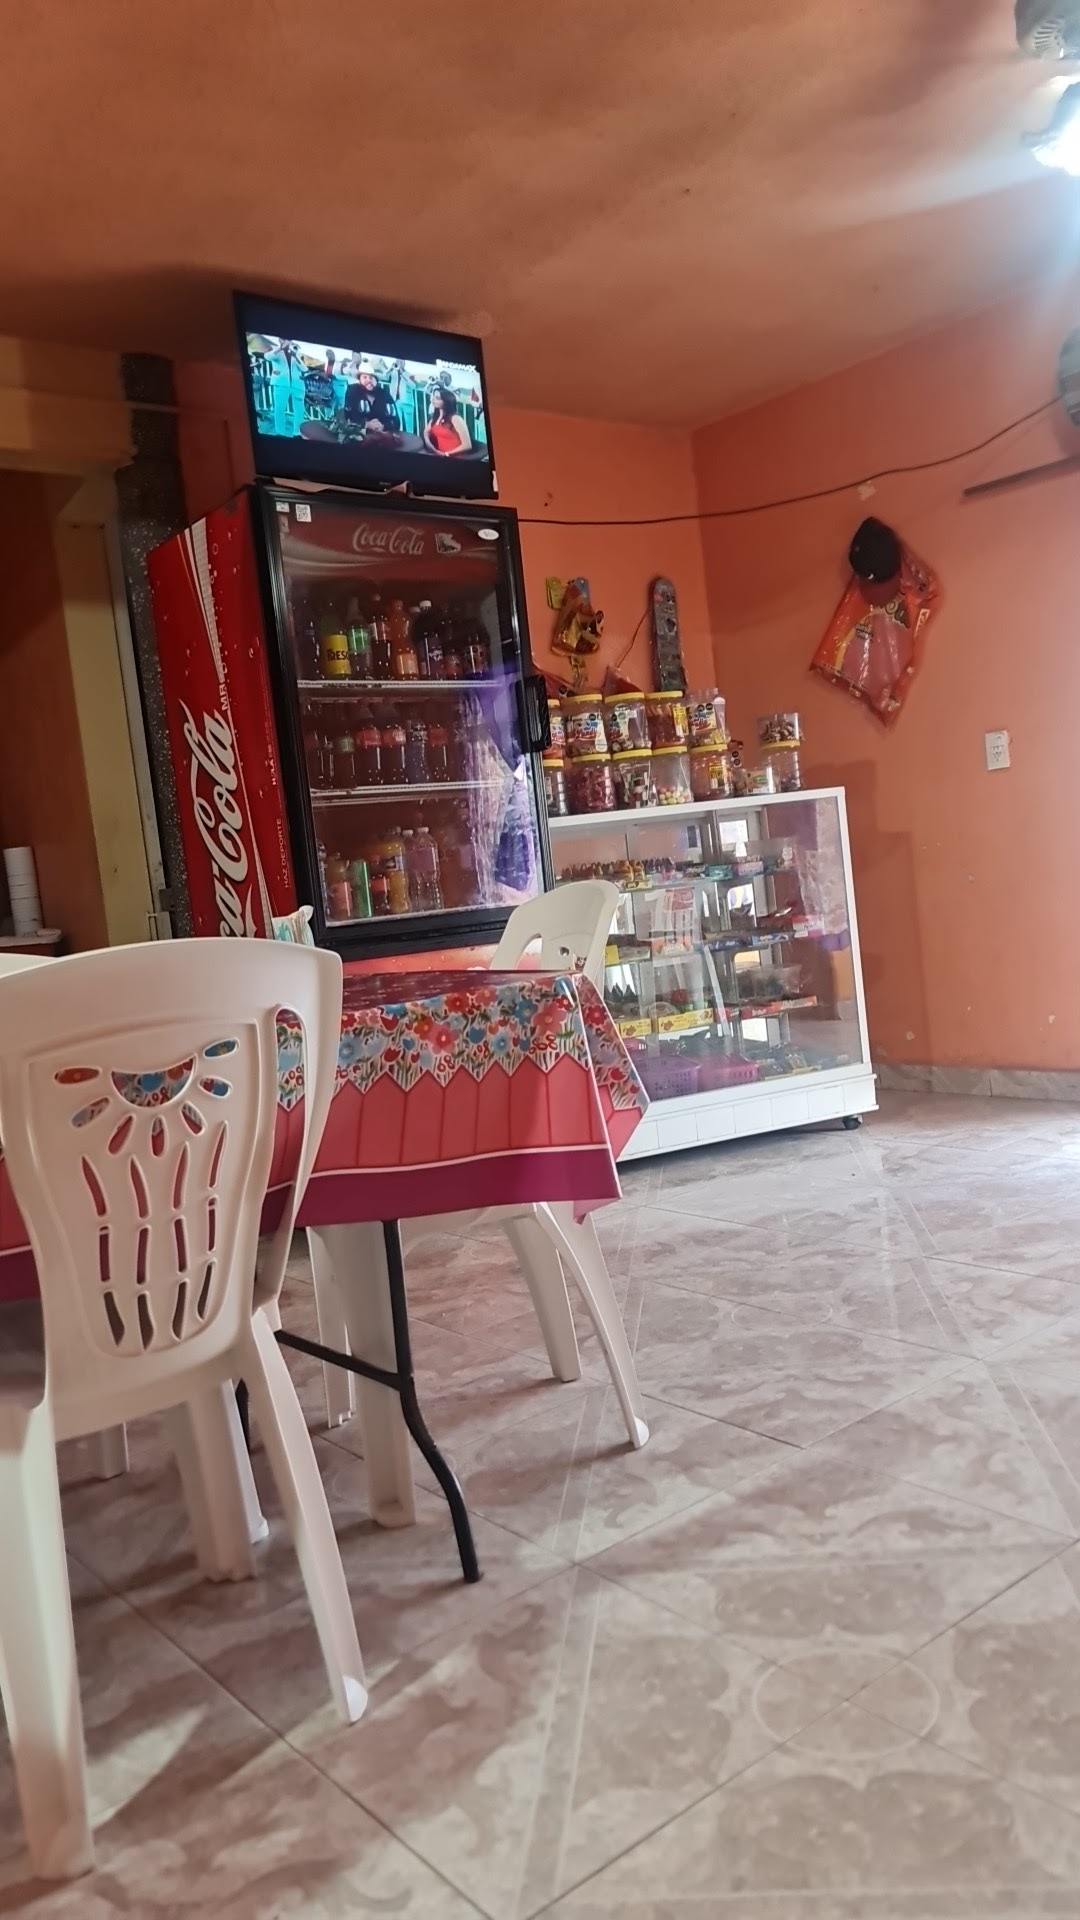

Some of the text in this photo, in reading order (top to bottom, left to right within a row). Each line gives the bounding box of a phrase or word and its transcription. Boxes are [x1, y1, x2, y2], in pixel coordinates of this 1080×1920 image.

[352, 523, 425, 555] Coca-Cola
[179, 698, 256, 938] ca-Cola
[276, 818, 286, 866] DEPORTE
